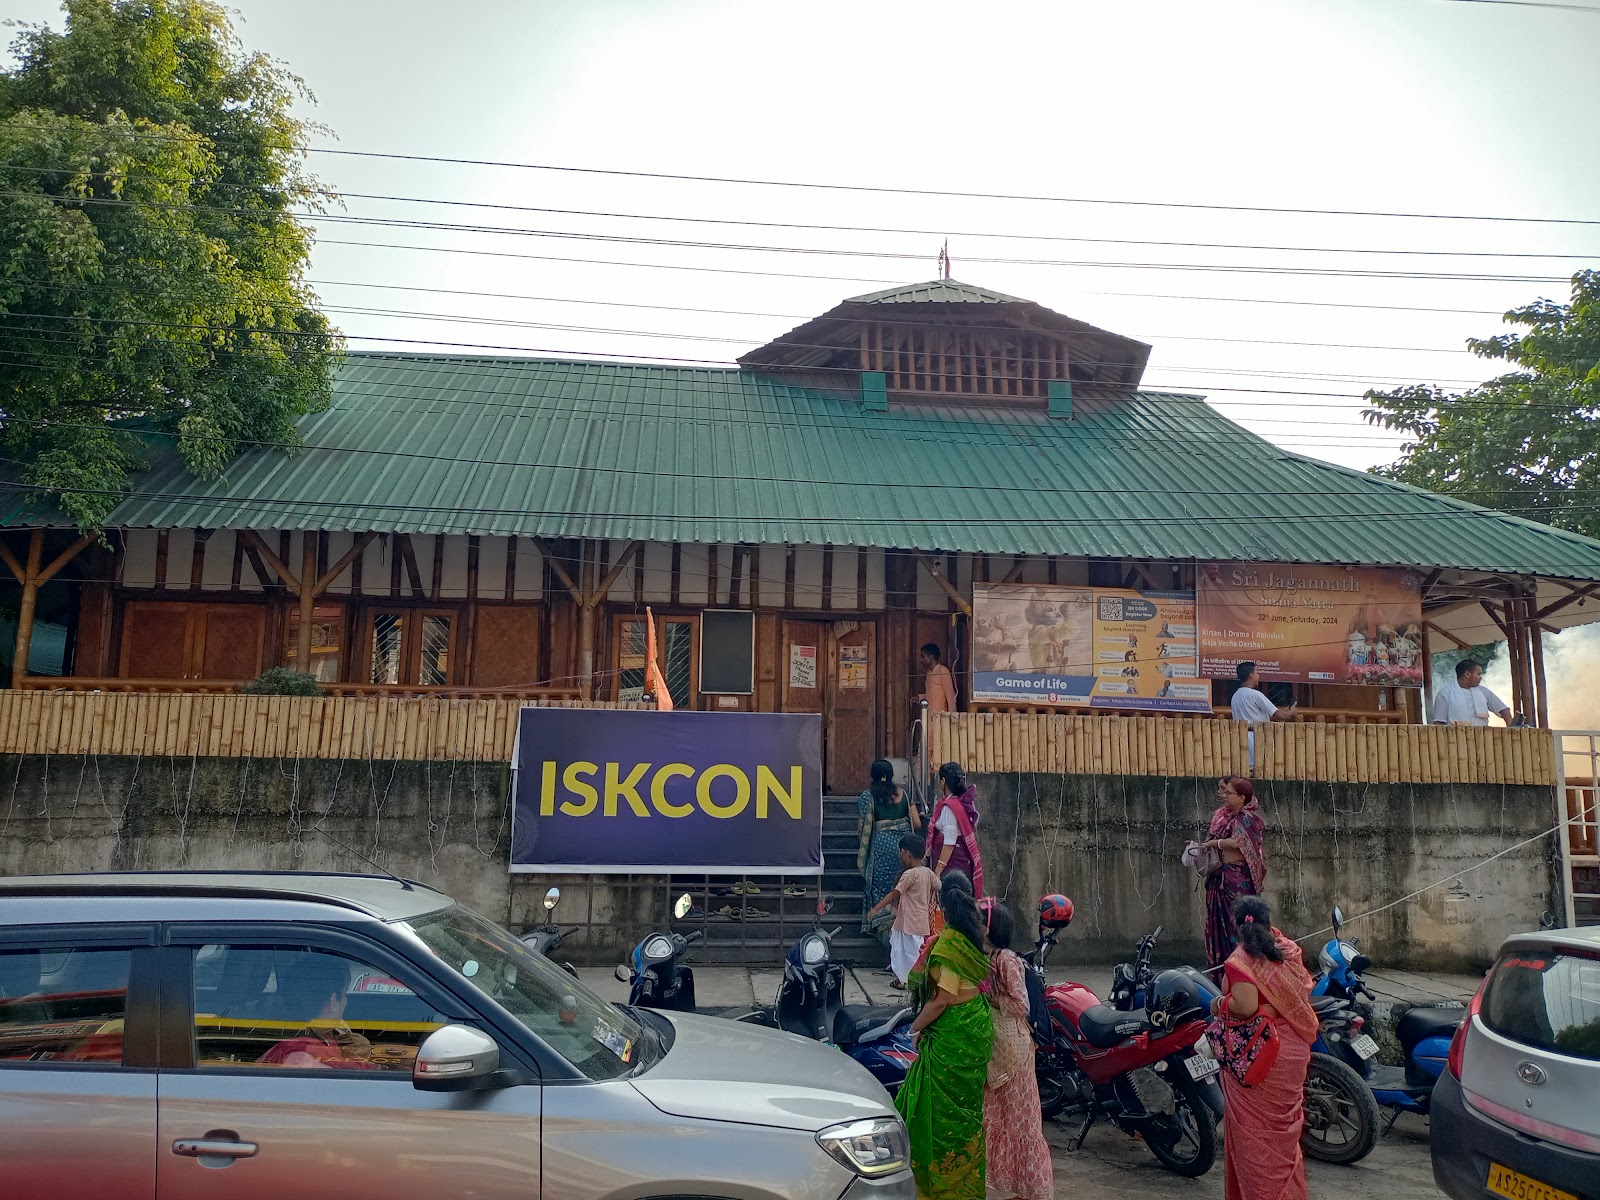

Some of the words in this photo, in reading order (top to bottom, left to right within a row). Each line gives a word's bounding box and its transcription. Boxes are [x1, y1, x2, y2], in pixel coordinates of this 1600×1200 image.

[1232, 570, 1259, 587] Sri
[1264, 571, 1360, 595] Jagannath
[1302, 598, 1335, 610] Yatra
[1322, 617, 1338, 625] 2024
[1202, 629, 1222, 637] Kirtan
[1256, 632, 1285, 640] Abhishek
[1202, 640, 1217, 648] Gaja
[1238, 641, 1265, 649] Darshan
[995, 677, 1032, 688] Game
[1033, 679, 1046, 689] of
[1046, 679, 1067, 690] Life
[539, 760, 803, 819] ISKCON
[1194, 1061, 1214, 1076] P7847
